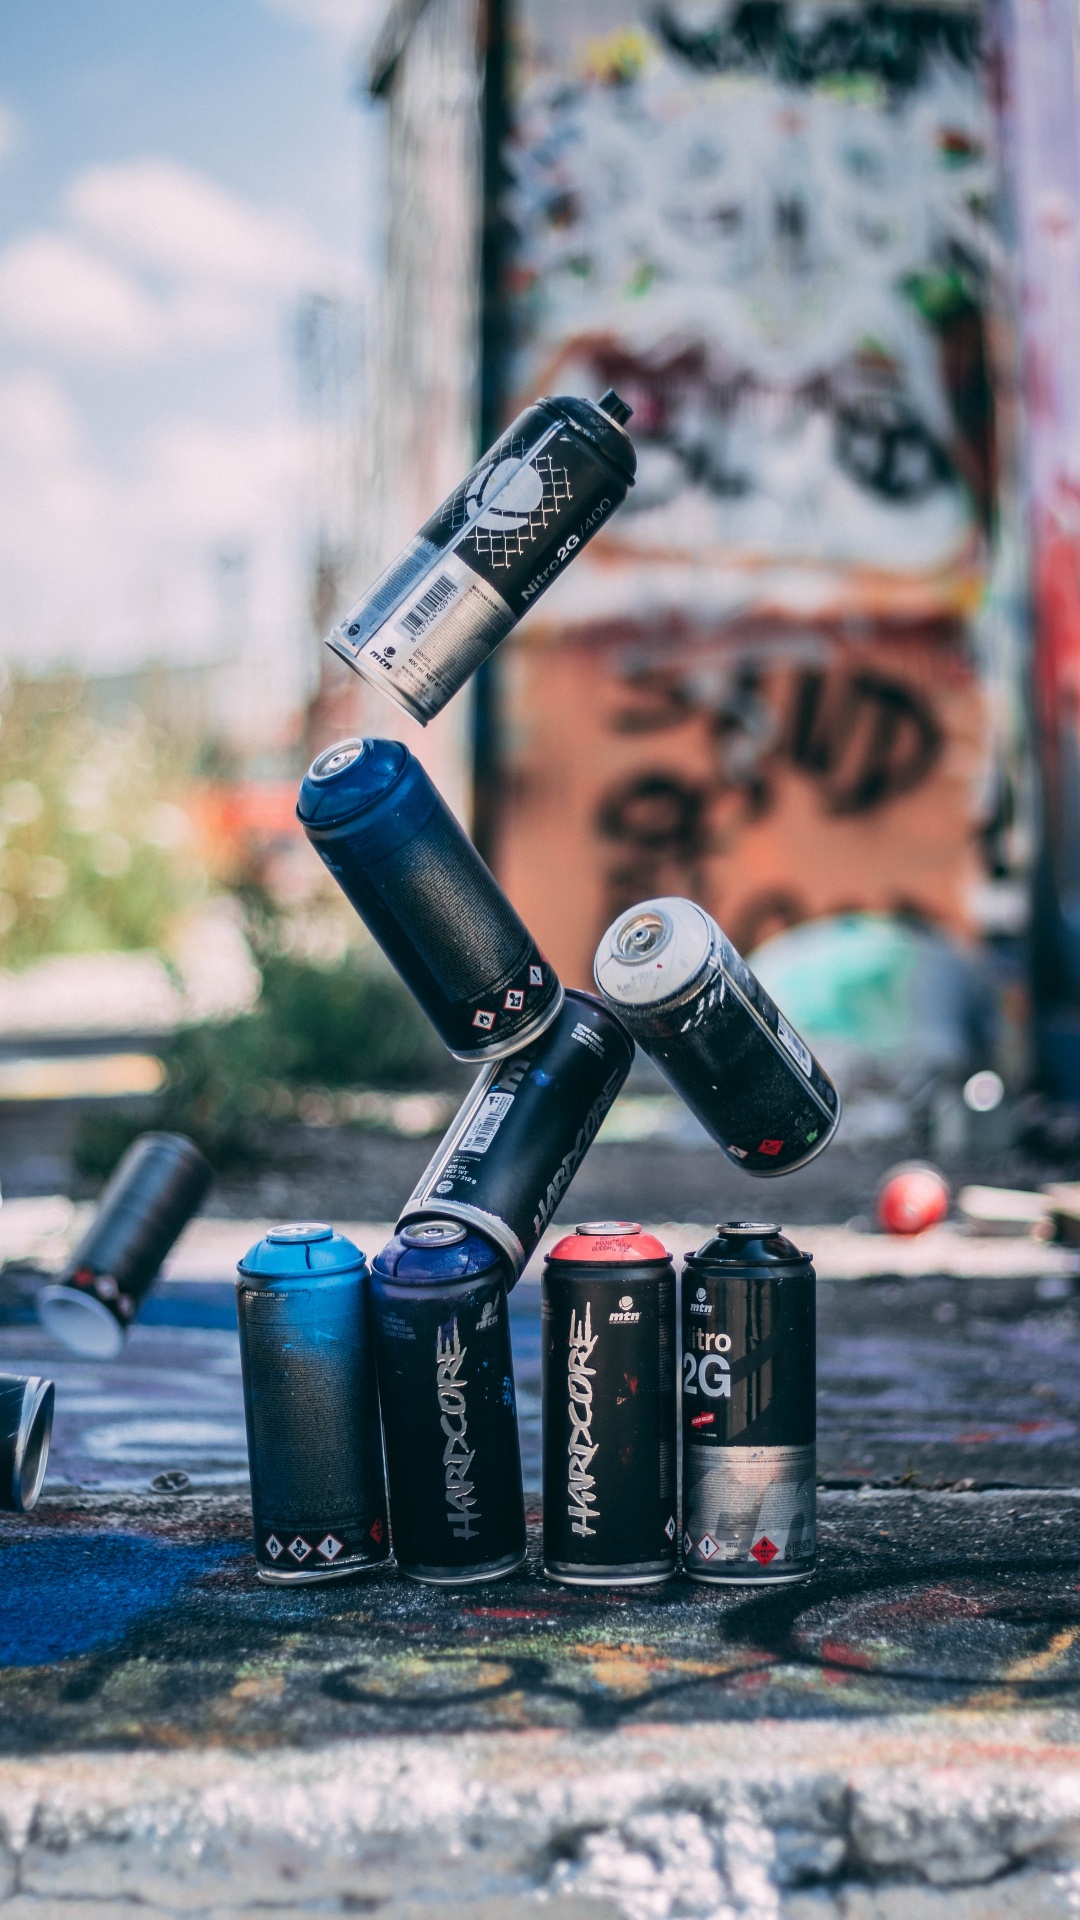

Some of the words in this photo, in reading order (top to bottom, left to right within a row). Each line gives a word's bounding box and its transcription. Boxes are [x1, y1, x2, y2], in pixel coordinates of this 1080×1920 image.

[369, 650, 393, 670] mtn
[407, 657, 418, 667] 400
[424, 672, 435, 683] NET
[609, 1312, 641, 1321] mtn
[690, 1302, 713, 1313] mtn
[691, 1326, 732, 1352] itro
[683, 1352, 731, 1398] 2G
[437, 1316, 482, 1540] HARDCORE
[568, 1302, 600, 1537] HARDCORE
